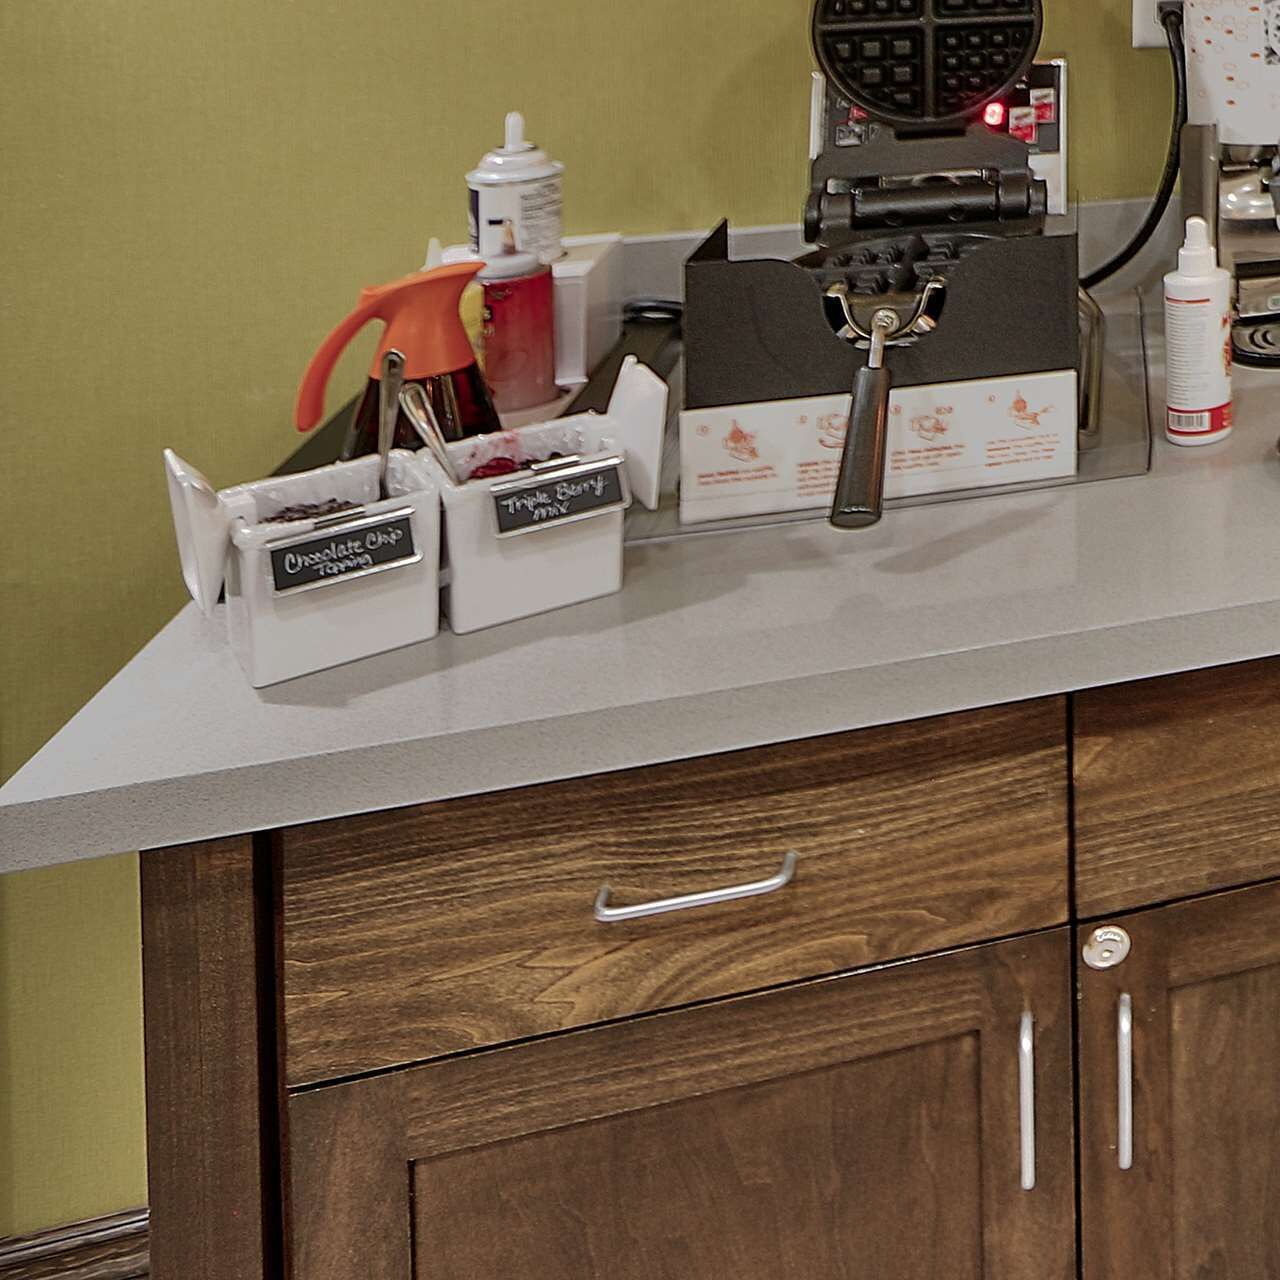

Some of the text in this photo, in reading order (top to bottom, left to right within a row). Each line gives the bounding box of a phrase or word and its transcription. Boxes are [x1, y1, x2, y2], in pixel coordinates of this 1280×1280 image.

[501, 475, 608, 514] Triple Berry
[365, 527, 404, 550] Chip
